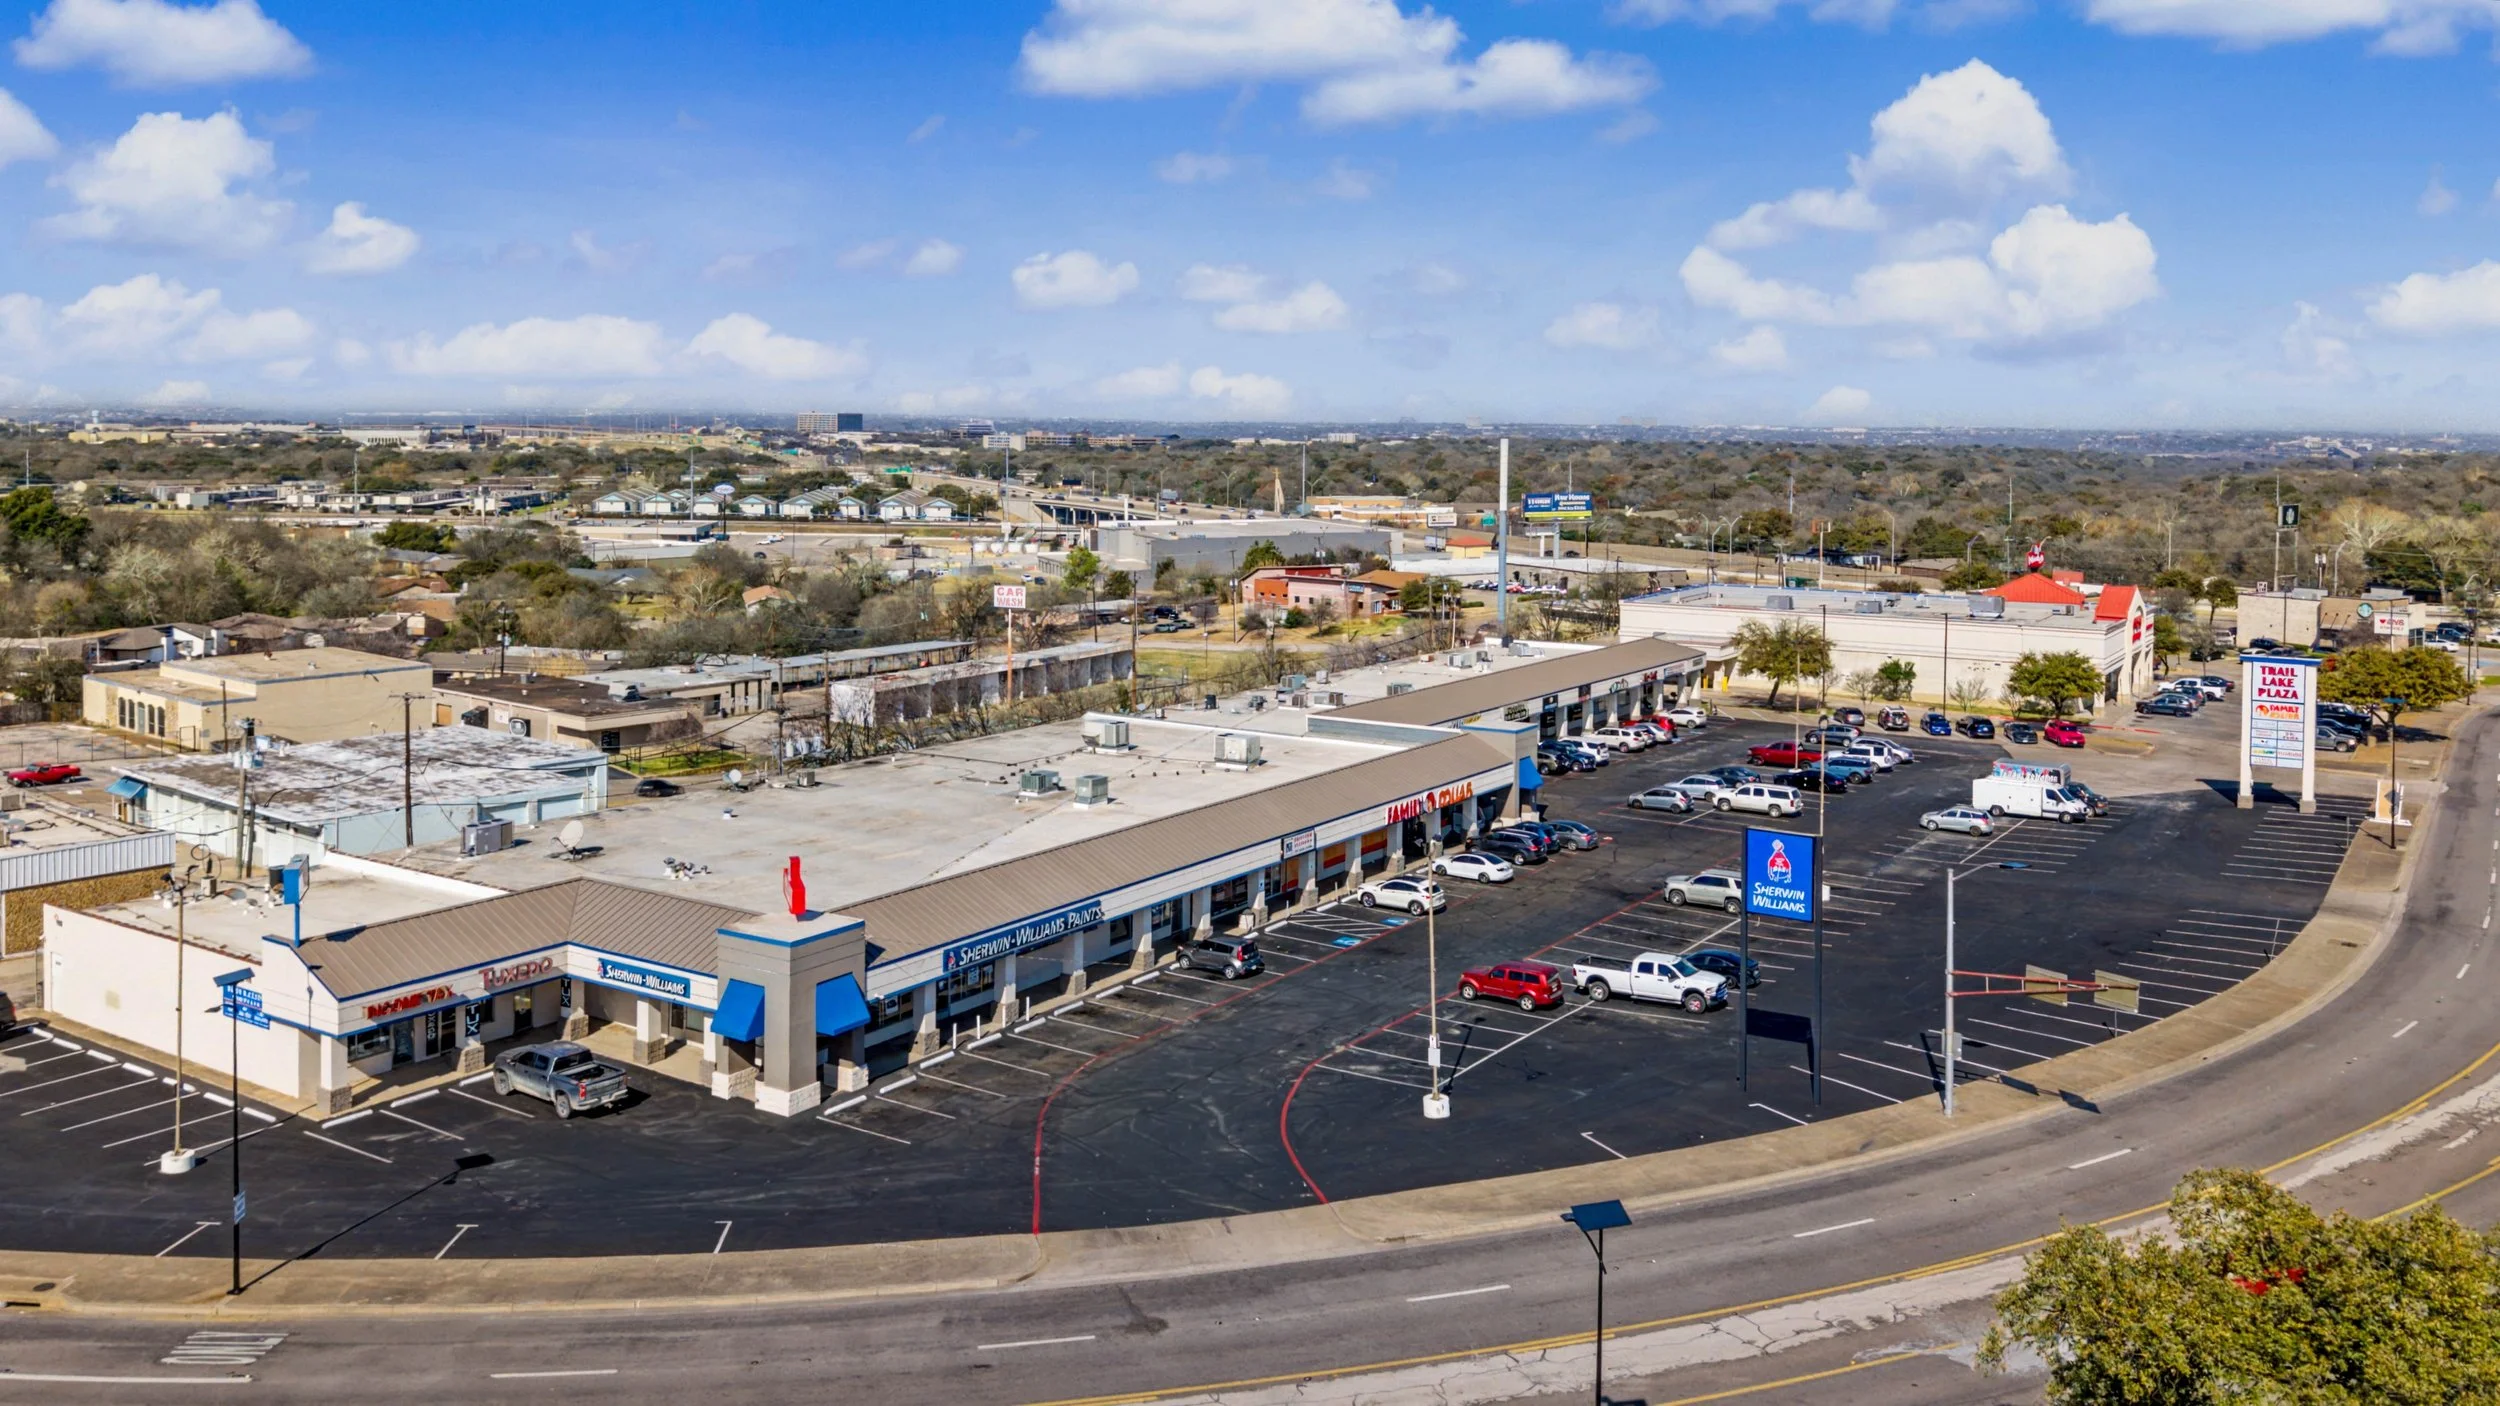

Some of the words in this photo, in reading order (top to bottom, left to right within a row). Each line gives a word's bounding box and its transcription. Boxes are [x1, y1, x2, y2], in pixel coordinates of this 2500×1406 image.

[997, 587, 1024, 596] CAR
[997, 597, 1023, 606] WASH
[2260, 665, 2298, 677] TRAIL
[2262, 677, 2295, 688] LAKE
[2257, 688, 2299, 699] PLAZA
[2270, 704, 2299, 713] FAMILY
[1386, 796, 1423, 825] FAMILY
[1437, 781, 1474, 808] DOLLAR
[1753, 882, 1805, 900] SHERWIN
[1752, 894, 1806, 914] WILLIAMS
[959, 917, 1065, 966] SHERWIN-WILLIAMS
[1067, 907, 1102, 929] PAINTS
[479, 956, 553, 989] TUXEDO
[605, 965, 685, 995] SHERWIN-WILLIAMS
[364, 992, 423, 1019] INCOME
[422, 984, 456, 1004] TAX
[561, 979, 571, 1006] TUX
[466, 1003, 480, 1035] TUX
